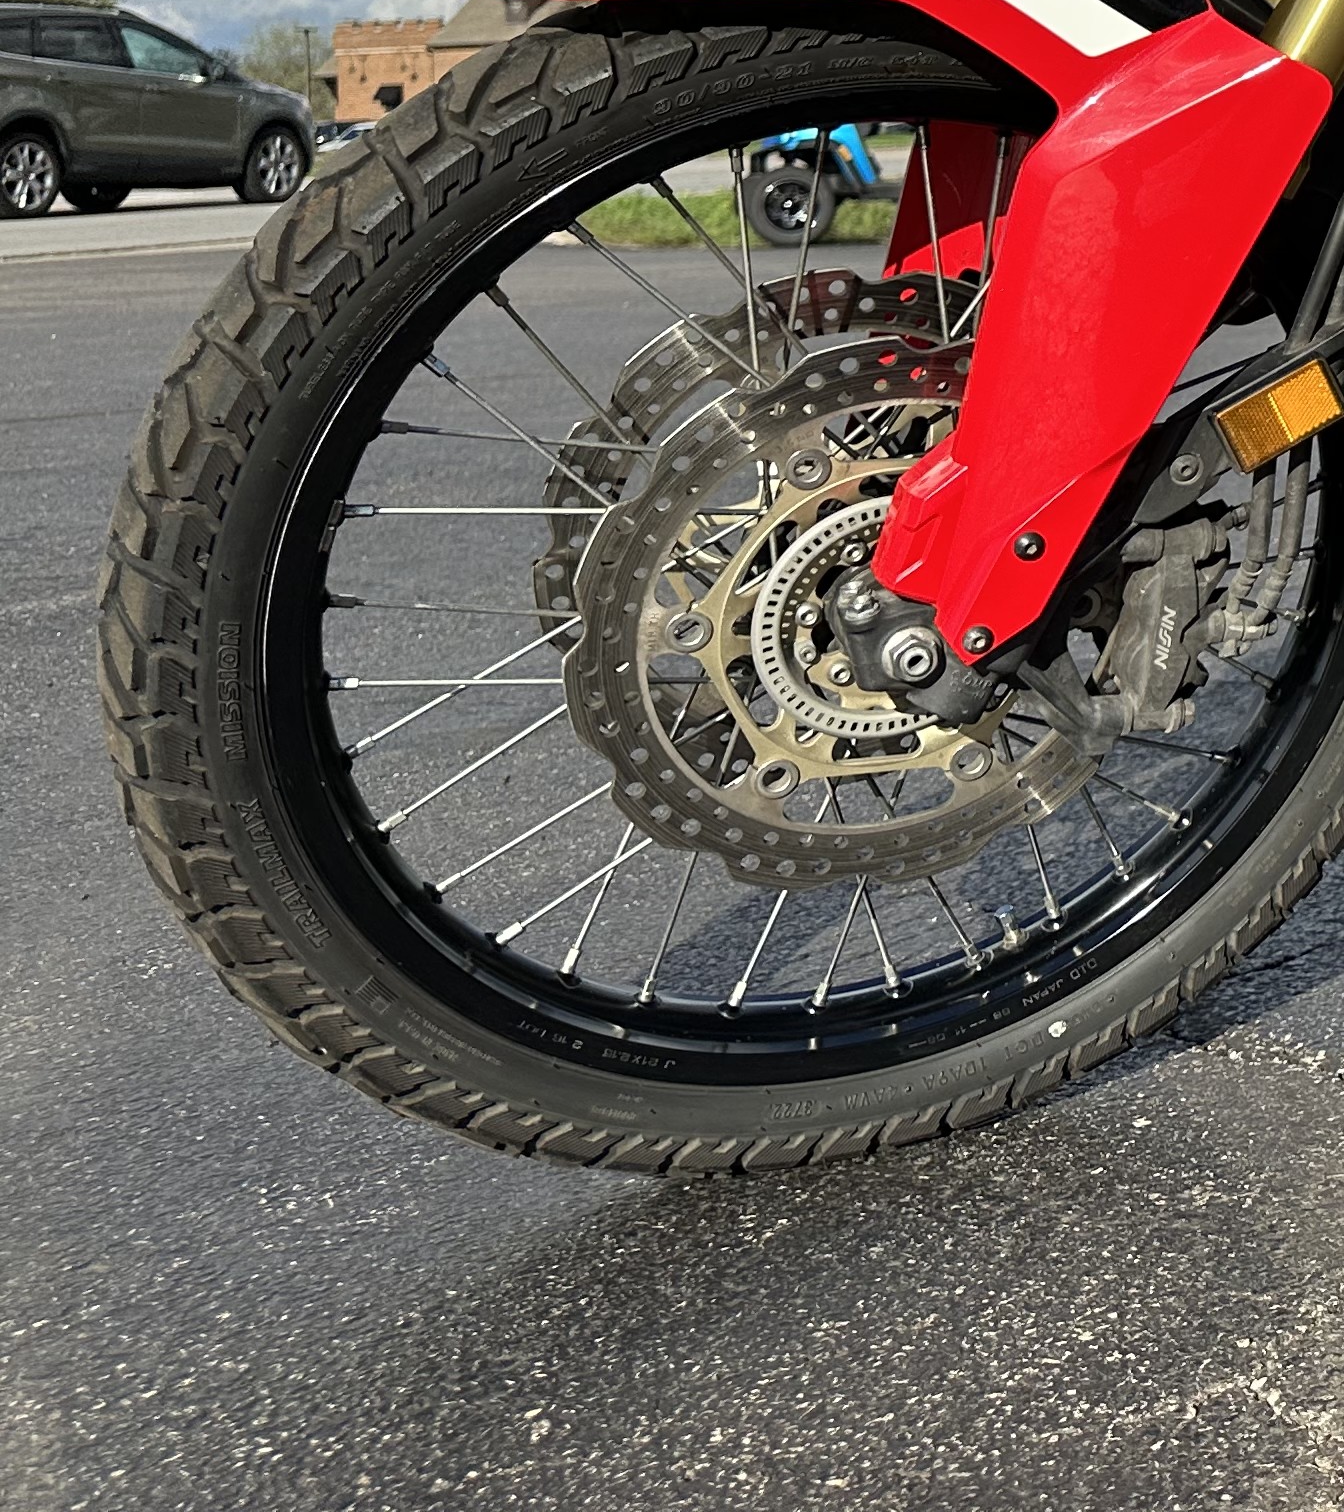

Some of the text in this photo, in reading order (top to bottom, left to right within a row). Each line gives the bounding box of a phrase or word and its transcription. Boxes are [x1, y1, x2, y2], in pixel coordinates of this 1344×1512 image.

[1153, 605, 1177, 670] NISSIN
[218, 622, 334, 950] TRAILMAX MISSION
